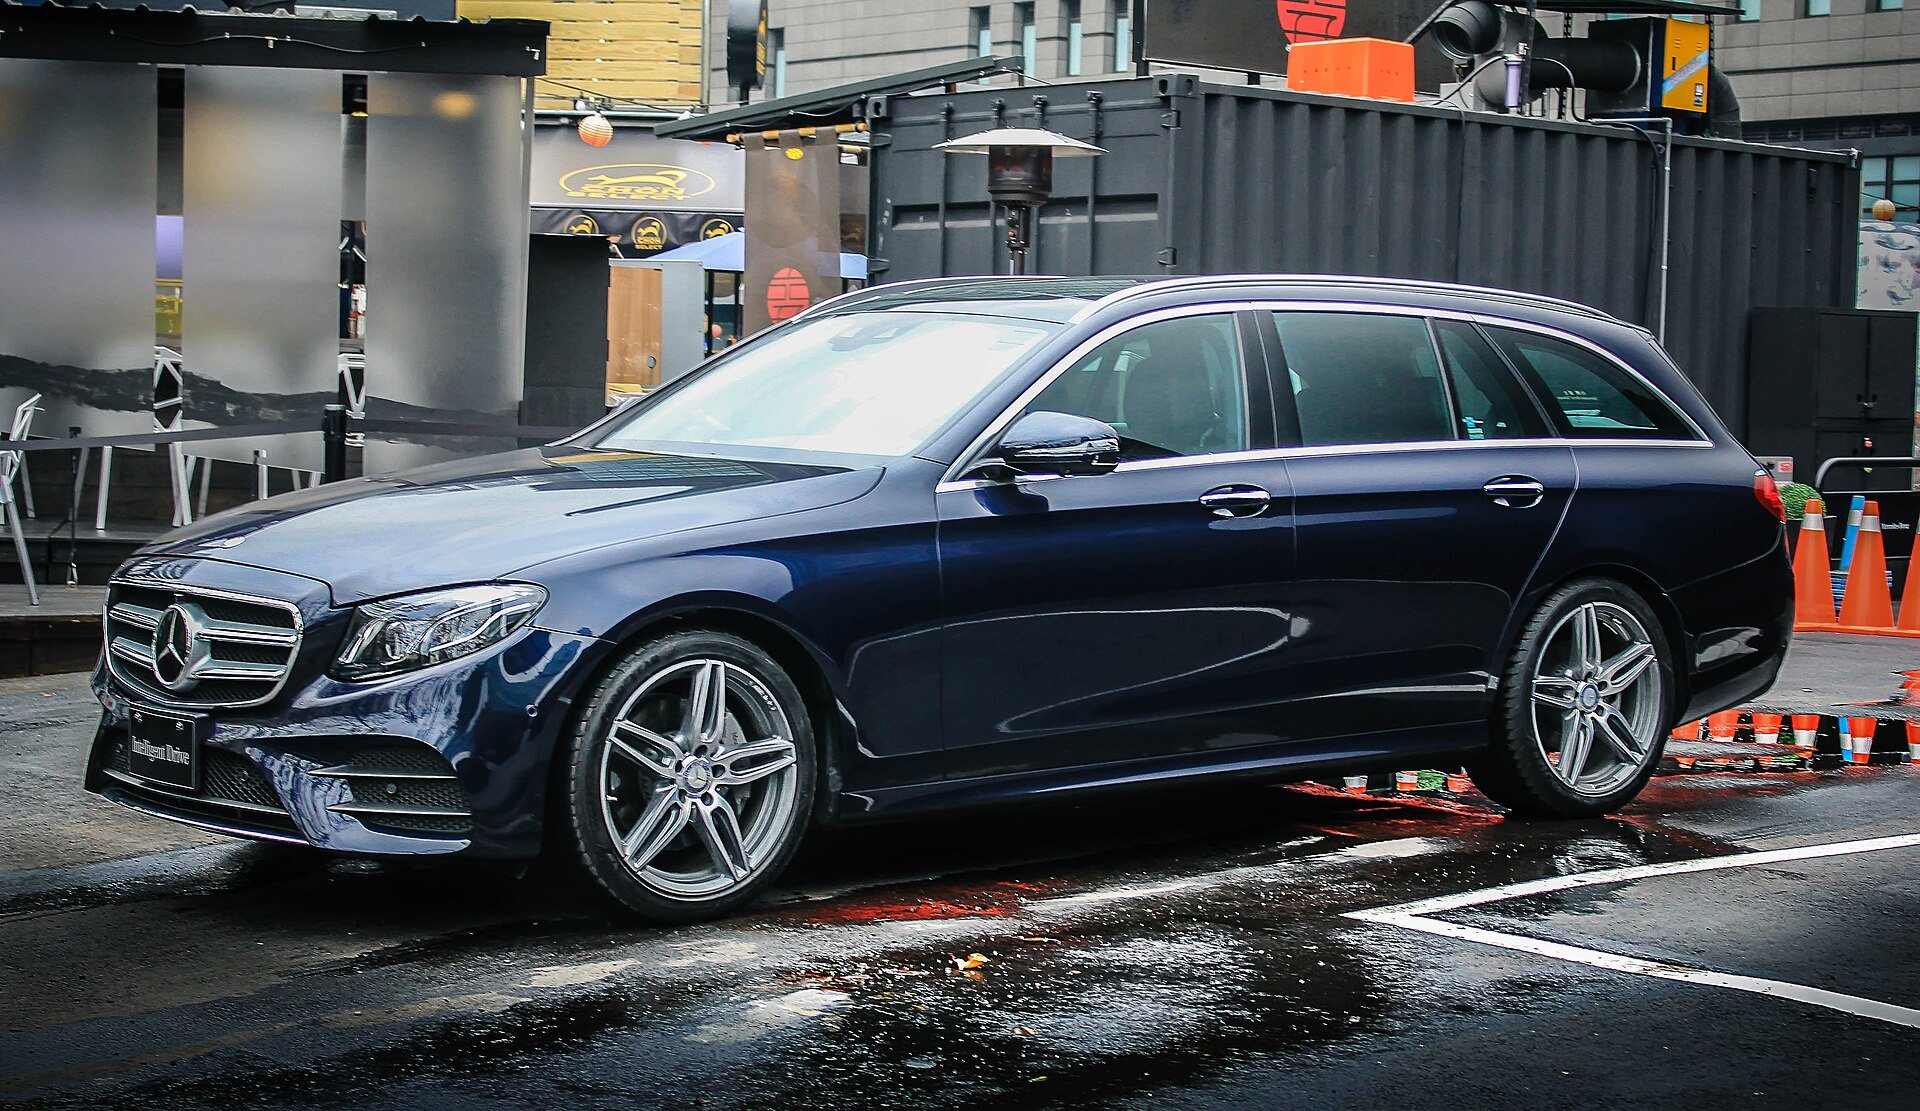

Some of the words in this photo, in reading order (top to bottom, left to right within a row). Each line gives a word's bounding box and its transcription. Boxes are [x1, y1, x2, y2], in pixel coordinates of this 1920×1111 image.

[566, 191, 691, 200] SELECT
[132, 735, 166, 762] Intelligent
[165, 743, 190, 765] Drive
